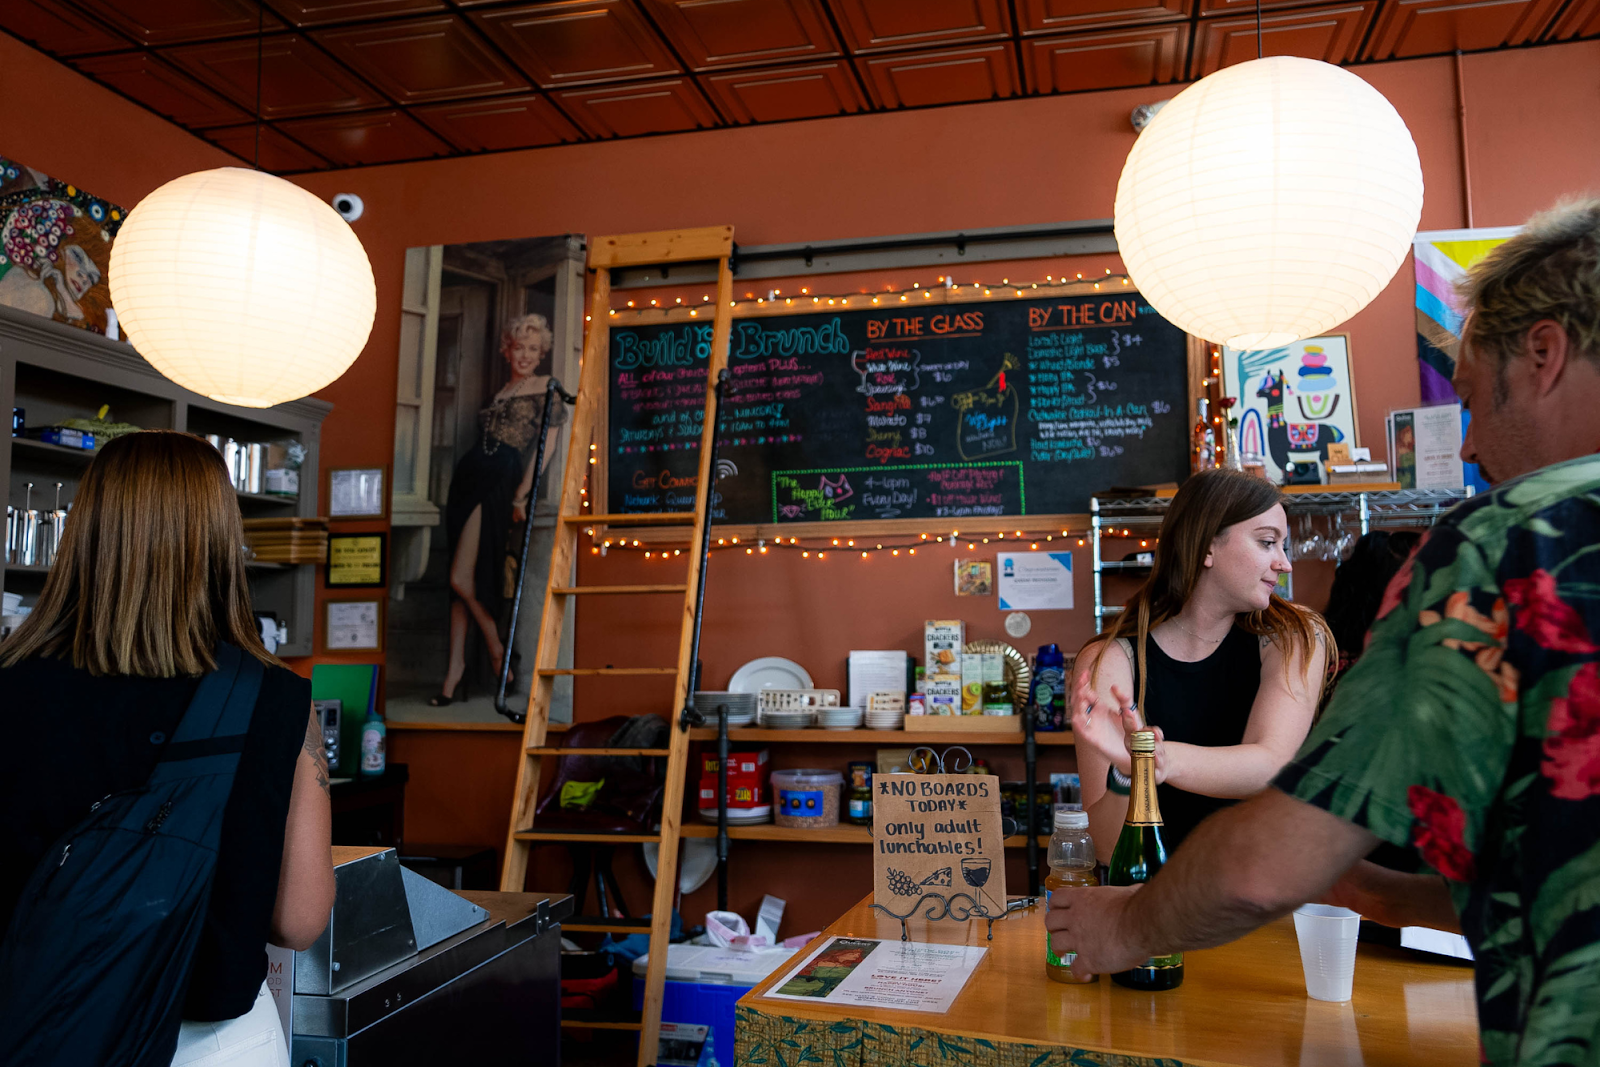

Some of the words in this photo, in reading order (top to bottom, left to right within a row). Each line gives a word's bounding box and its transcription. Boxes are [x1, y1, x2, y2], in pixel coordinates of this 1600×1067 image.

[1029, 306, 1053, 327] BY
[1057, 303, 1096, 325] THE
[1099, 300, 1137, 322] CAN
[866, 319, 889, 339] BY
[891, 316, 924, 336] THE
[930, 311, 984, 334] GLASS
[614, 326, 694, 369] Build
[736, 316, 850, 359] Brunch
[865, 443, 912, 464] Cognac
[927, 632, 960, 642] CRACKERS
[927, 687, 960, 697] CRACKERS
[920, 781, 990, 799] BOARDS
[885, 820, 926, 841] only
[934, 818, 983, 835] adult
[879, 837, 984, 856] lunchables!
